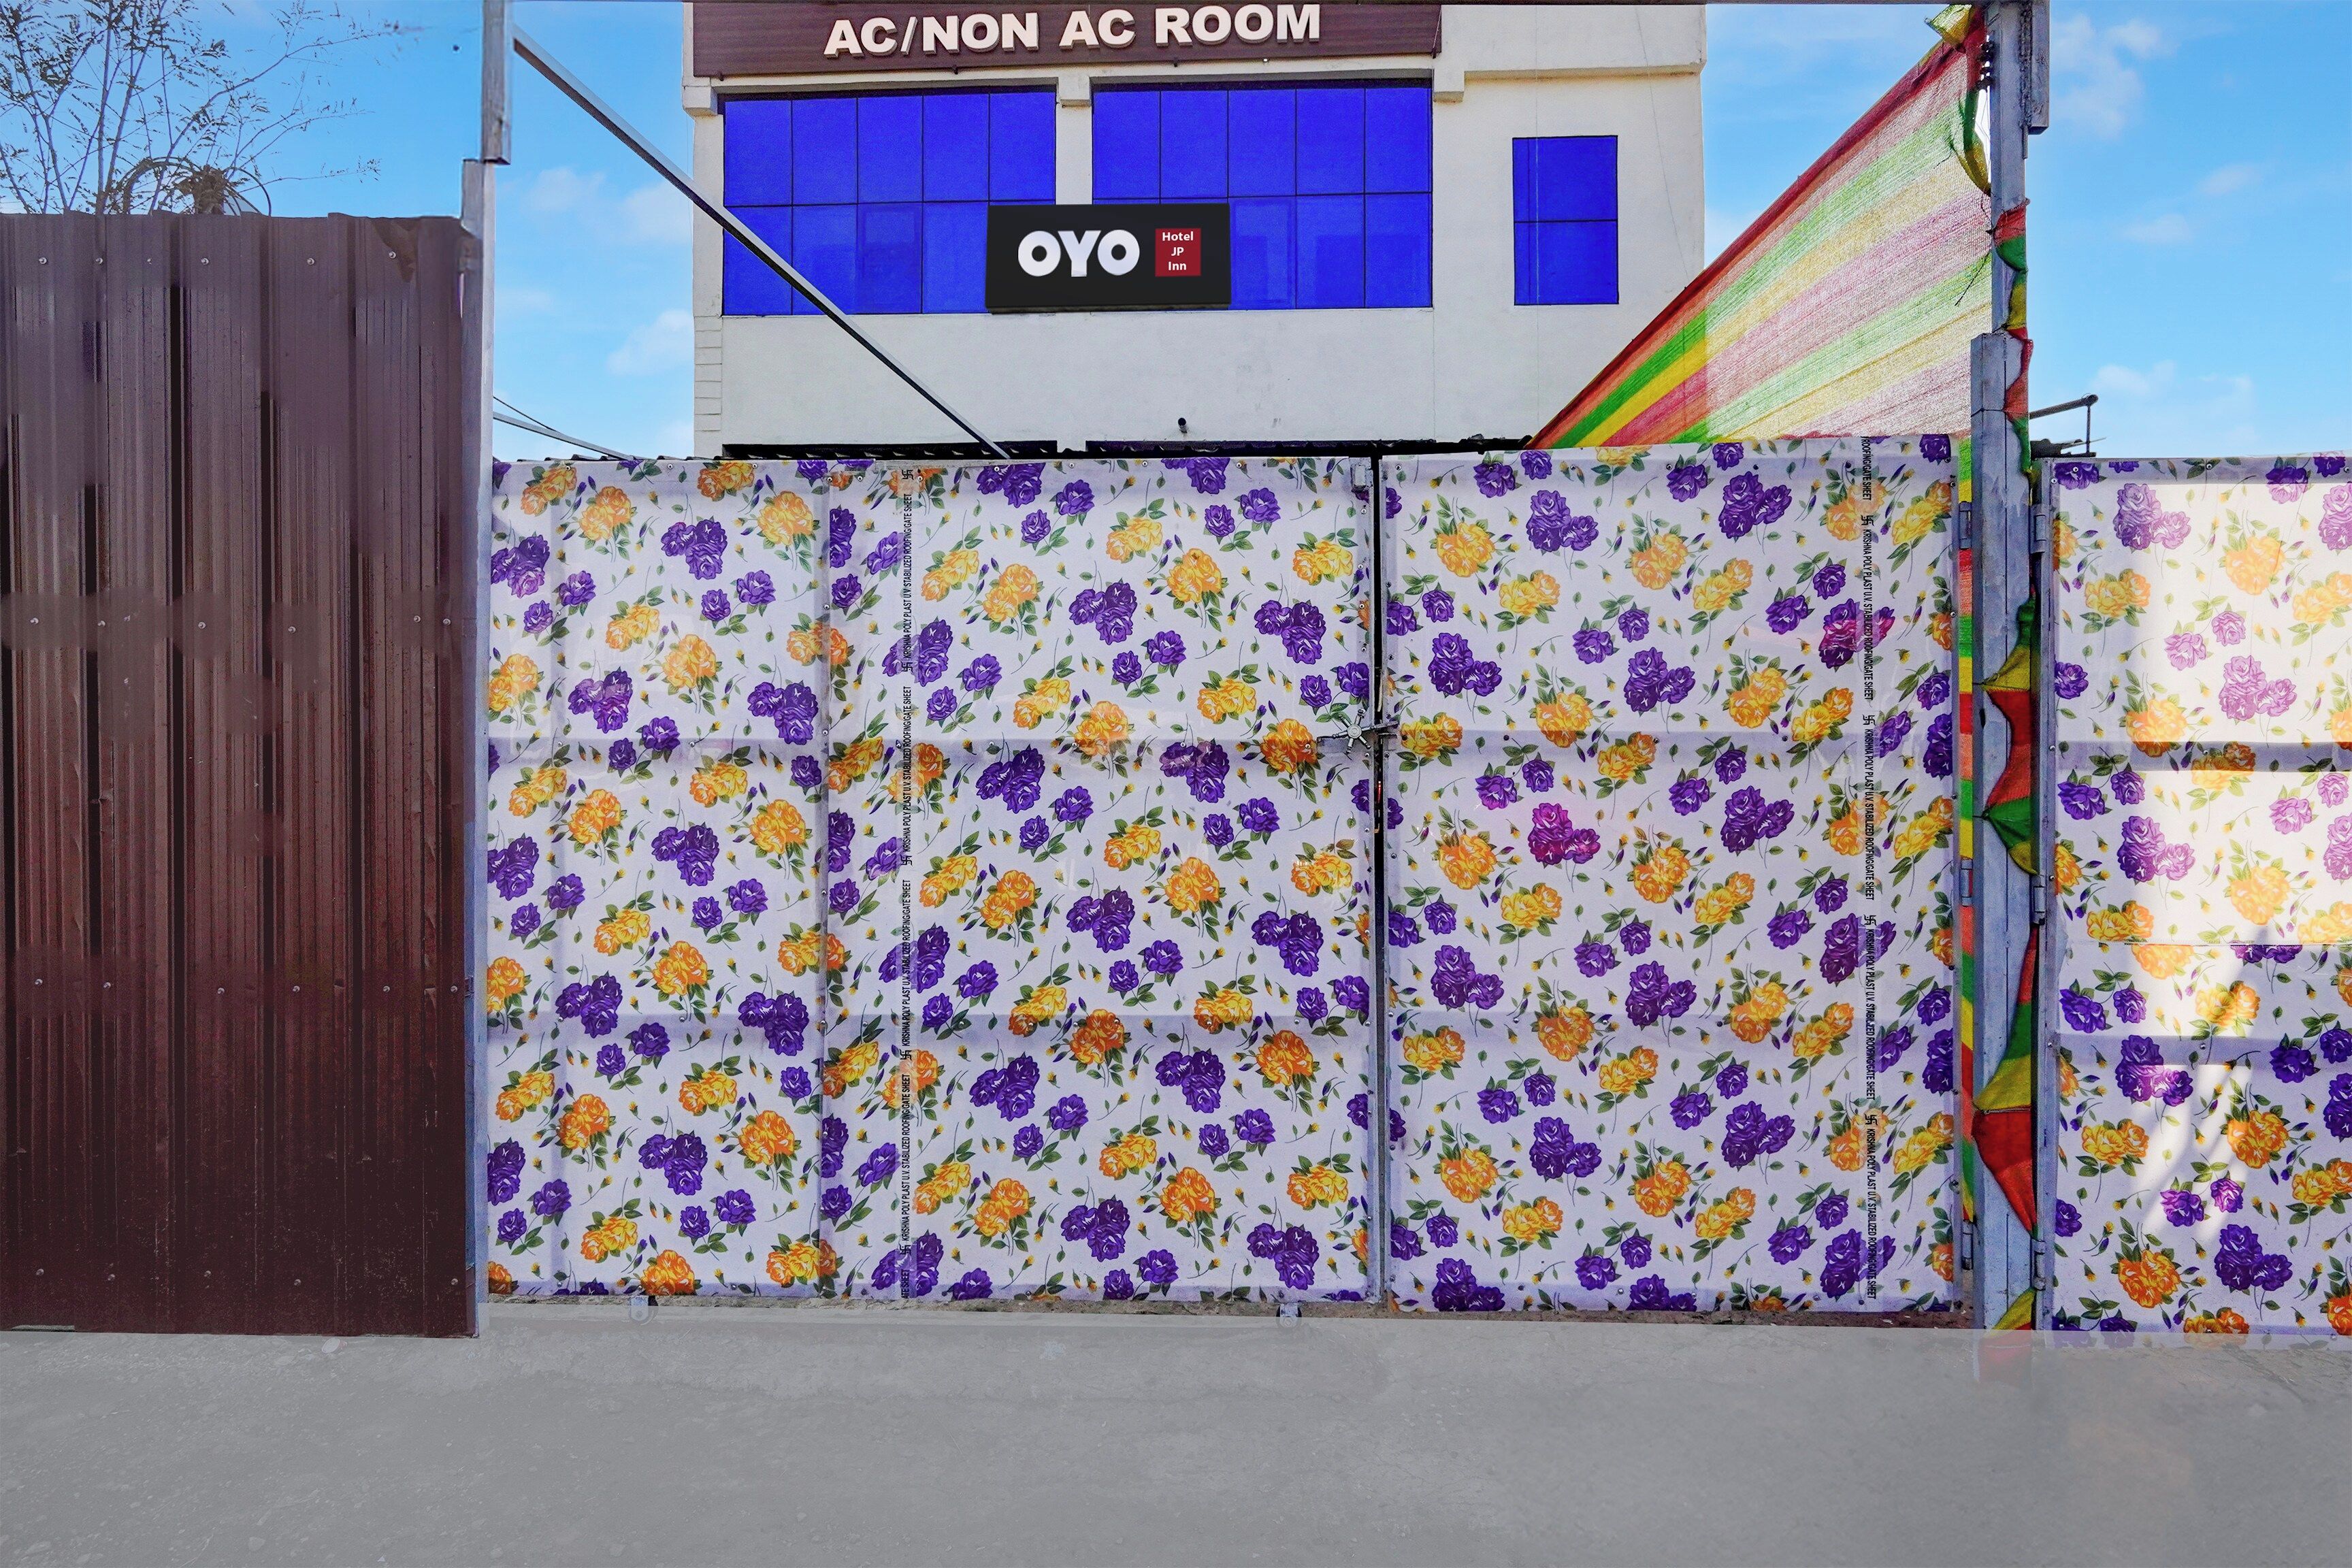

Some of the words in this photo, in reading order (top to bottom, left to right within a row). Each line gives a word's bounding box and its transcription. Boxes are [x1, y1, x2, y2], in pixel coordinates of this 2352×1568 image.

[823, 11, 1039, 58] AC/NON
[1060, 8, 1136, 50] AC
[1155, 3, 1321, 46] ROOM
[1162, 231, 1194, 242] Hotel
[1018, 229, 1140, 277] OYO
[1171, 246, 1184, 257] JP
[1168, 261, 1187, 271] Inn
[1861, 440, 1872, 480] ROOFING/GATE
[1863, 482, 1872, 501] SHEET
[903, 494, 912, 511] SHEET
[903, 513, 912, 554] ROOFING/GATE
[1863, 529, 1872, 555] KRISHNA
[903, 556, 912, 587] STABILIZED
[1863, 556, 1872, 570] POLY
[1863, 572, 1872, 591] PLAST
[903, 588, 912, 598] U.V.
[1863, 592, 1872, 602] U.V.
[903, 599, 912, 617] PLAST
[903, 618, 912, 633] POLY
[1863, 604, 1872, 636] STABILIZED
[903, 634, 912, 659] KRISHNA
[1863, 638, 1872, 681] ROOFING/GATE
[902, 686, 911, 704] SHEET
[1863, 682, 1872, 700] SHEET
[902, 706, 911, 747] ROOFING/GATE
[1865, 729, 1874, 754] KRISHNA
[902, 749, 911, 780] STABILIZED
[1865, 755, 1874, 770] POLY
[902, 781, 911, 791] U.V.
[1865, 772, 1874, 790] PLAST
[902, 792, 911, 810] PLAST
[1865, 792, 1874, 802] U.V.
[902, 811, 911, 826] POLY
[1865, 804, 1874, 836] STABILIZED
[902, 828, 911, 852] KRISHNA
[1865, 838, 1874, 880] ROOFING/GATE
[902, 879, 911, 898] SHEET
[1865, 882, 1874, 900] SHEET
[902, 900, 911, 941] ROOFING/GATE
[1866, 929, 1875, 954] KRISHNA
[902, 942, 911, 974] STABILIZED
[1866, 956, 1875, 970] POLY
[902, 975, 911, 985] U.V.
[1866, 972, 1875, 990] PLAST
[902, 987, 911, 1004] PLAST
[1866, 992, 1875, 1002] U.V.
[902, 1006, 911, 1020] POLY
[902, 1022, 911, 1047] KRISHNA
[1866, 1037, 1875, 1079] ROOFING/GATE
[902, 1074, 910, 1092] SHEET
[1866, 1081, 1875, 1100] SHEET
[902, 1094, 910, 1135] ROOFING/GATE
[1867, 1128, 1876, 1154] KRISHNA
[902, 1137, 910, 1169] STABILIZED
[1867, 1156, 1876, 1171] POLY
[902, 1170, 910, 1180] U.V.
[1867, 1171, 1876, 1190] PLAST
[902, 1181, 910, 1199] PLAST
[1867, 1192, 1876, 1202] U.V.
[902, 1200, 910, 1215] POLY
[902, 1216, 910, 1241] KRISHNA
[1867, 1203, 1876, 1236] STABILIZED
[1867, 1237, 1876, 1279] ROOFING/GATE
[901, 1269, 909, 1288] SHEET
[1867, 1281, 1876, 1299] SHEET
